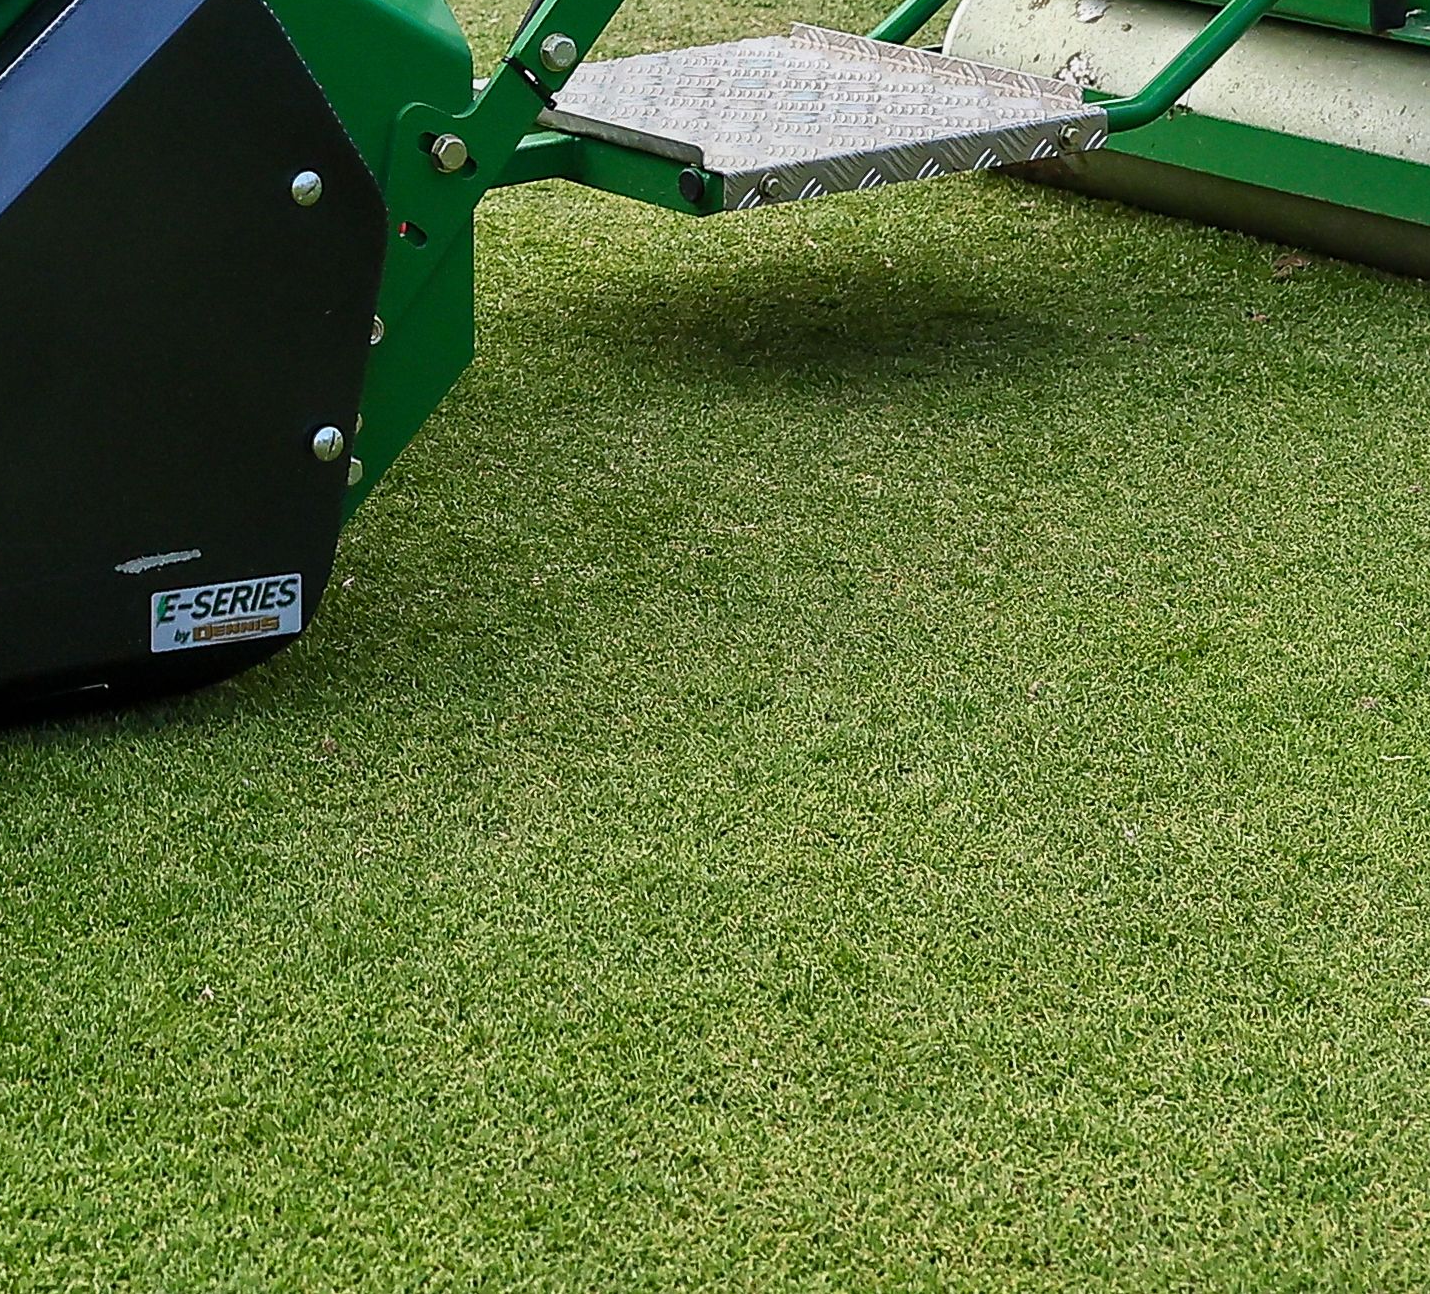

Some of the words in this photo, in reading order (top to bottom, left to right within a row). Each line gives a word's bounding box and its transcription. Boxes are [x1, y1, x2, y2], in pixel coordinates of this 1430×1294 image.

[156, 578, 298, 628] E-SERIES
[174, 627, 190, 644] by
[192, 616, 280, 642] DENNIS
